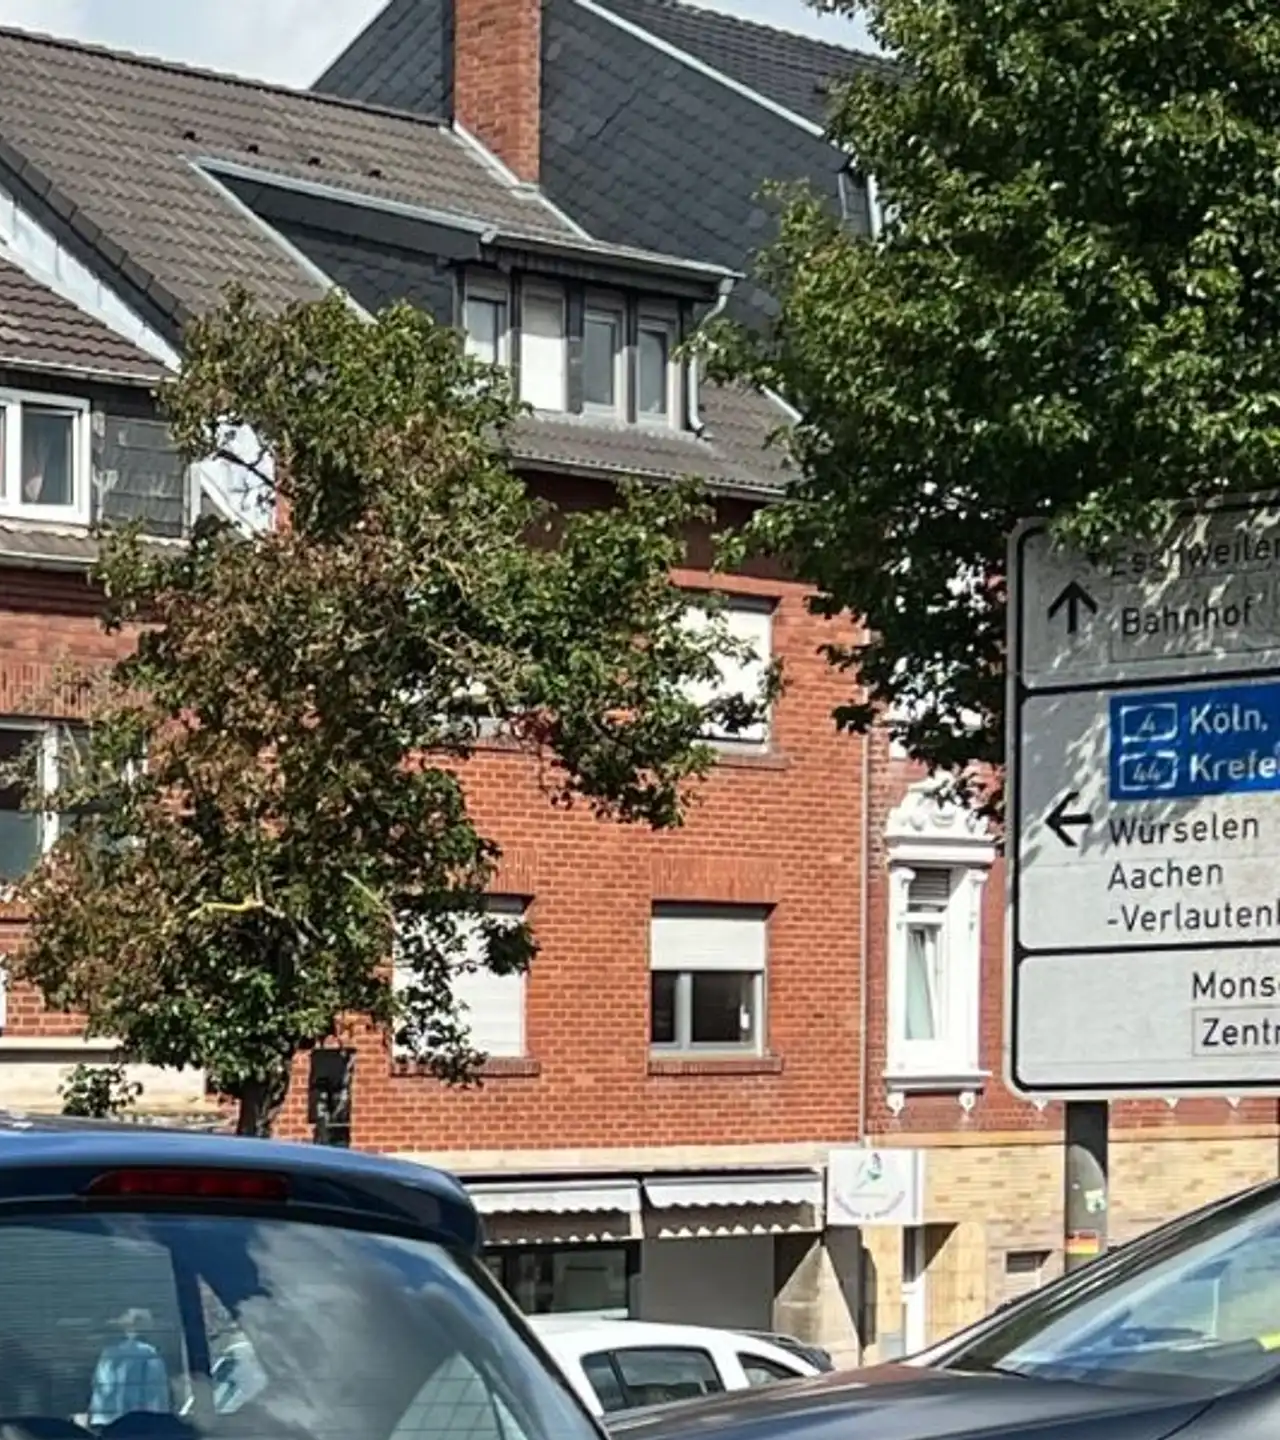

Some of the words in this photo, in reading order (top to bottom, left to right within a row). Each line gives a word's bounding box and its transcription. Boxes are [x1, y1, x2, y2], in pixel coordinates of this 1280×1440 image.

[1122, 595, 1253, 636] Bahnhof
[1139, 711, 1156, 732] 4
[1190, 750, 1280, 782] Krefe
[1109, 812, 1259, 846] Würselen
[1107, 858, 1224, 891] Aachen
[1107, 898, 1280, 933] -Verlauten
[1192, 970, 1280, 999] Mons
